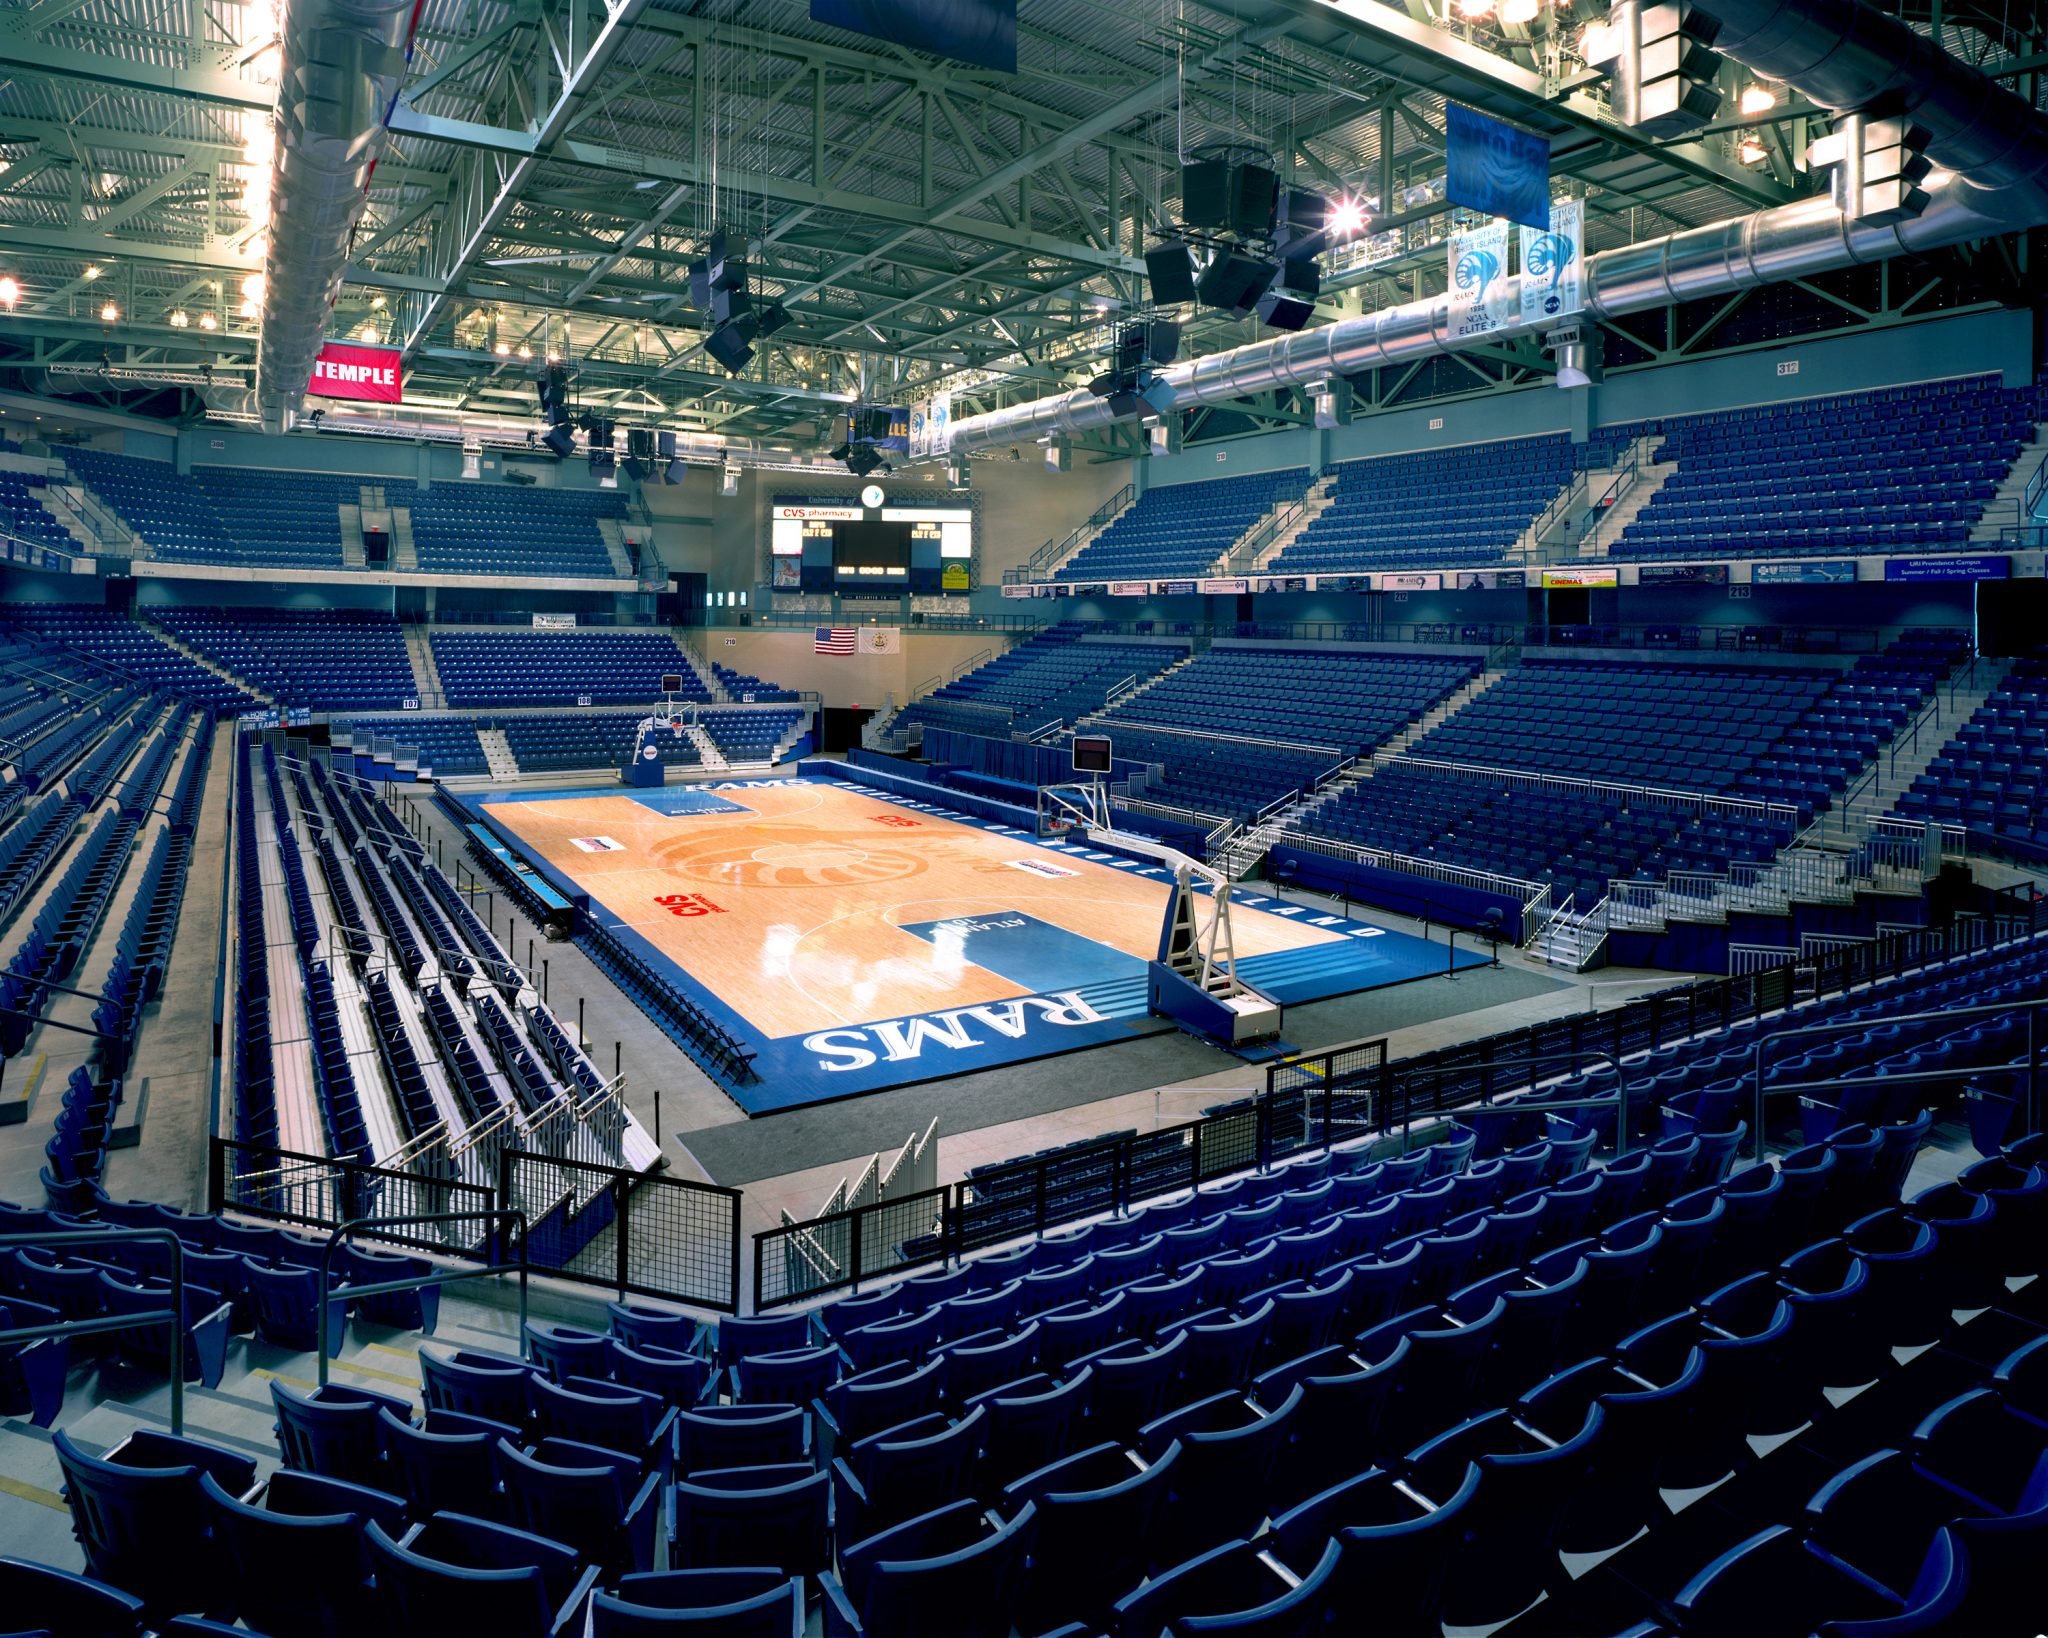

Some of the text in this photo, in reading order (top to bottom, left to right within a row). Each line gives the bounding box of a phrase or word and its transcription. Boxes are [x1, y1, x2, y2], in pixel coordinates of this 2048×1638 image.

[1466, 313, 1488, 324] NCAA
[1459, 320, 1496, 335] ELITE 8
[315, 360, 394, 385] TEMPLE
[1779, 362, 1797, 374] 312
[808, 496, 844, 505] University
[846, 497, 856, 506] of
[783, 508, 852, 518] CVS pharmacy
[1956, 559, 1981, 567] Campus
[1395, 592, 1407, 600] 212
[1731, 587, 1749, 597] 213
[404, 700, 416, 708] 107
[259, 720, 279, 729] RAMS
[686, 779, 813, 791] RAMS
[878, 815, 922, 827] CVS
[1360, 855, 1375, 867] 112
[653, 894, 709, 917] CVS
[803, 990, 1113, 1072] RAMS
